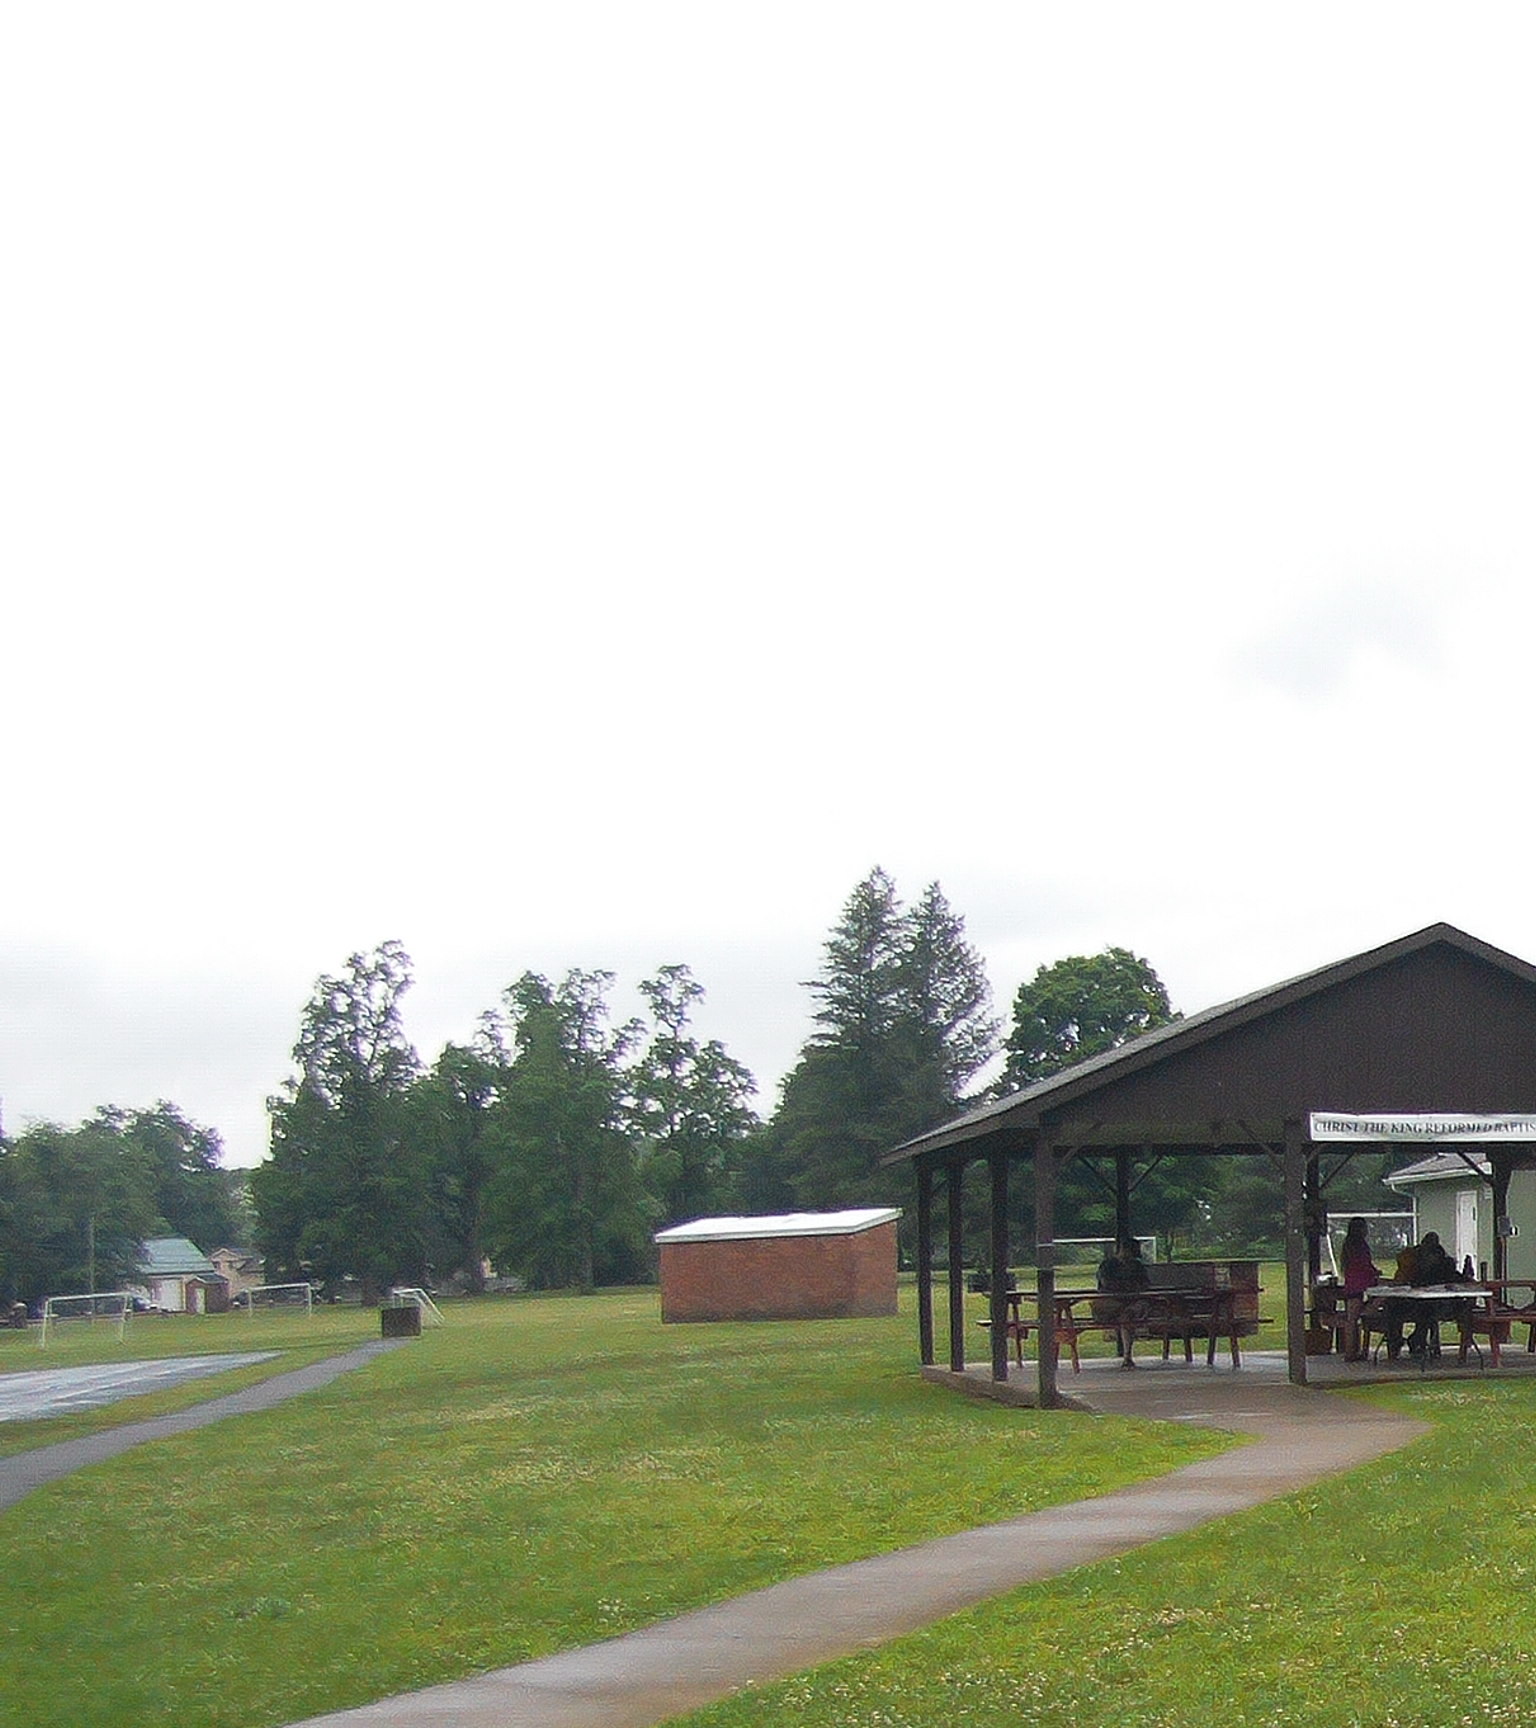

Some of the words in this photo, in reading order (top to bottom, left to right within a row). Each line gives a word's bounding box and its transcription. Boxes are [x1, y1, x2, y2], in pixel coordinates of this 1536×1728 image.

[1315, 1121, 1359, 1133] CHRIST
[1364, 1122, 1389, 1133] THE
[1391, 1122, 1422, 1133] KING
[1425, 1122, 1492, 1134] REFORMED
